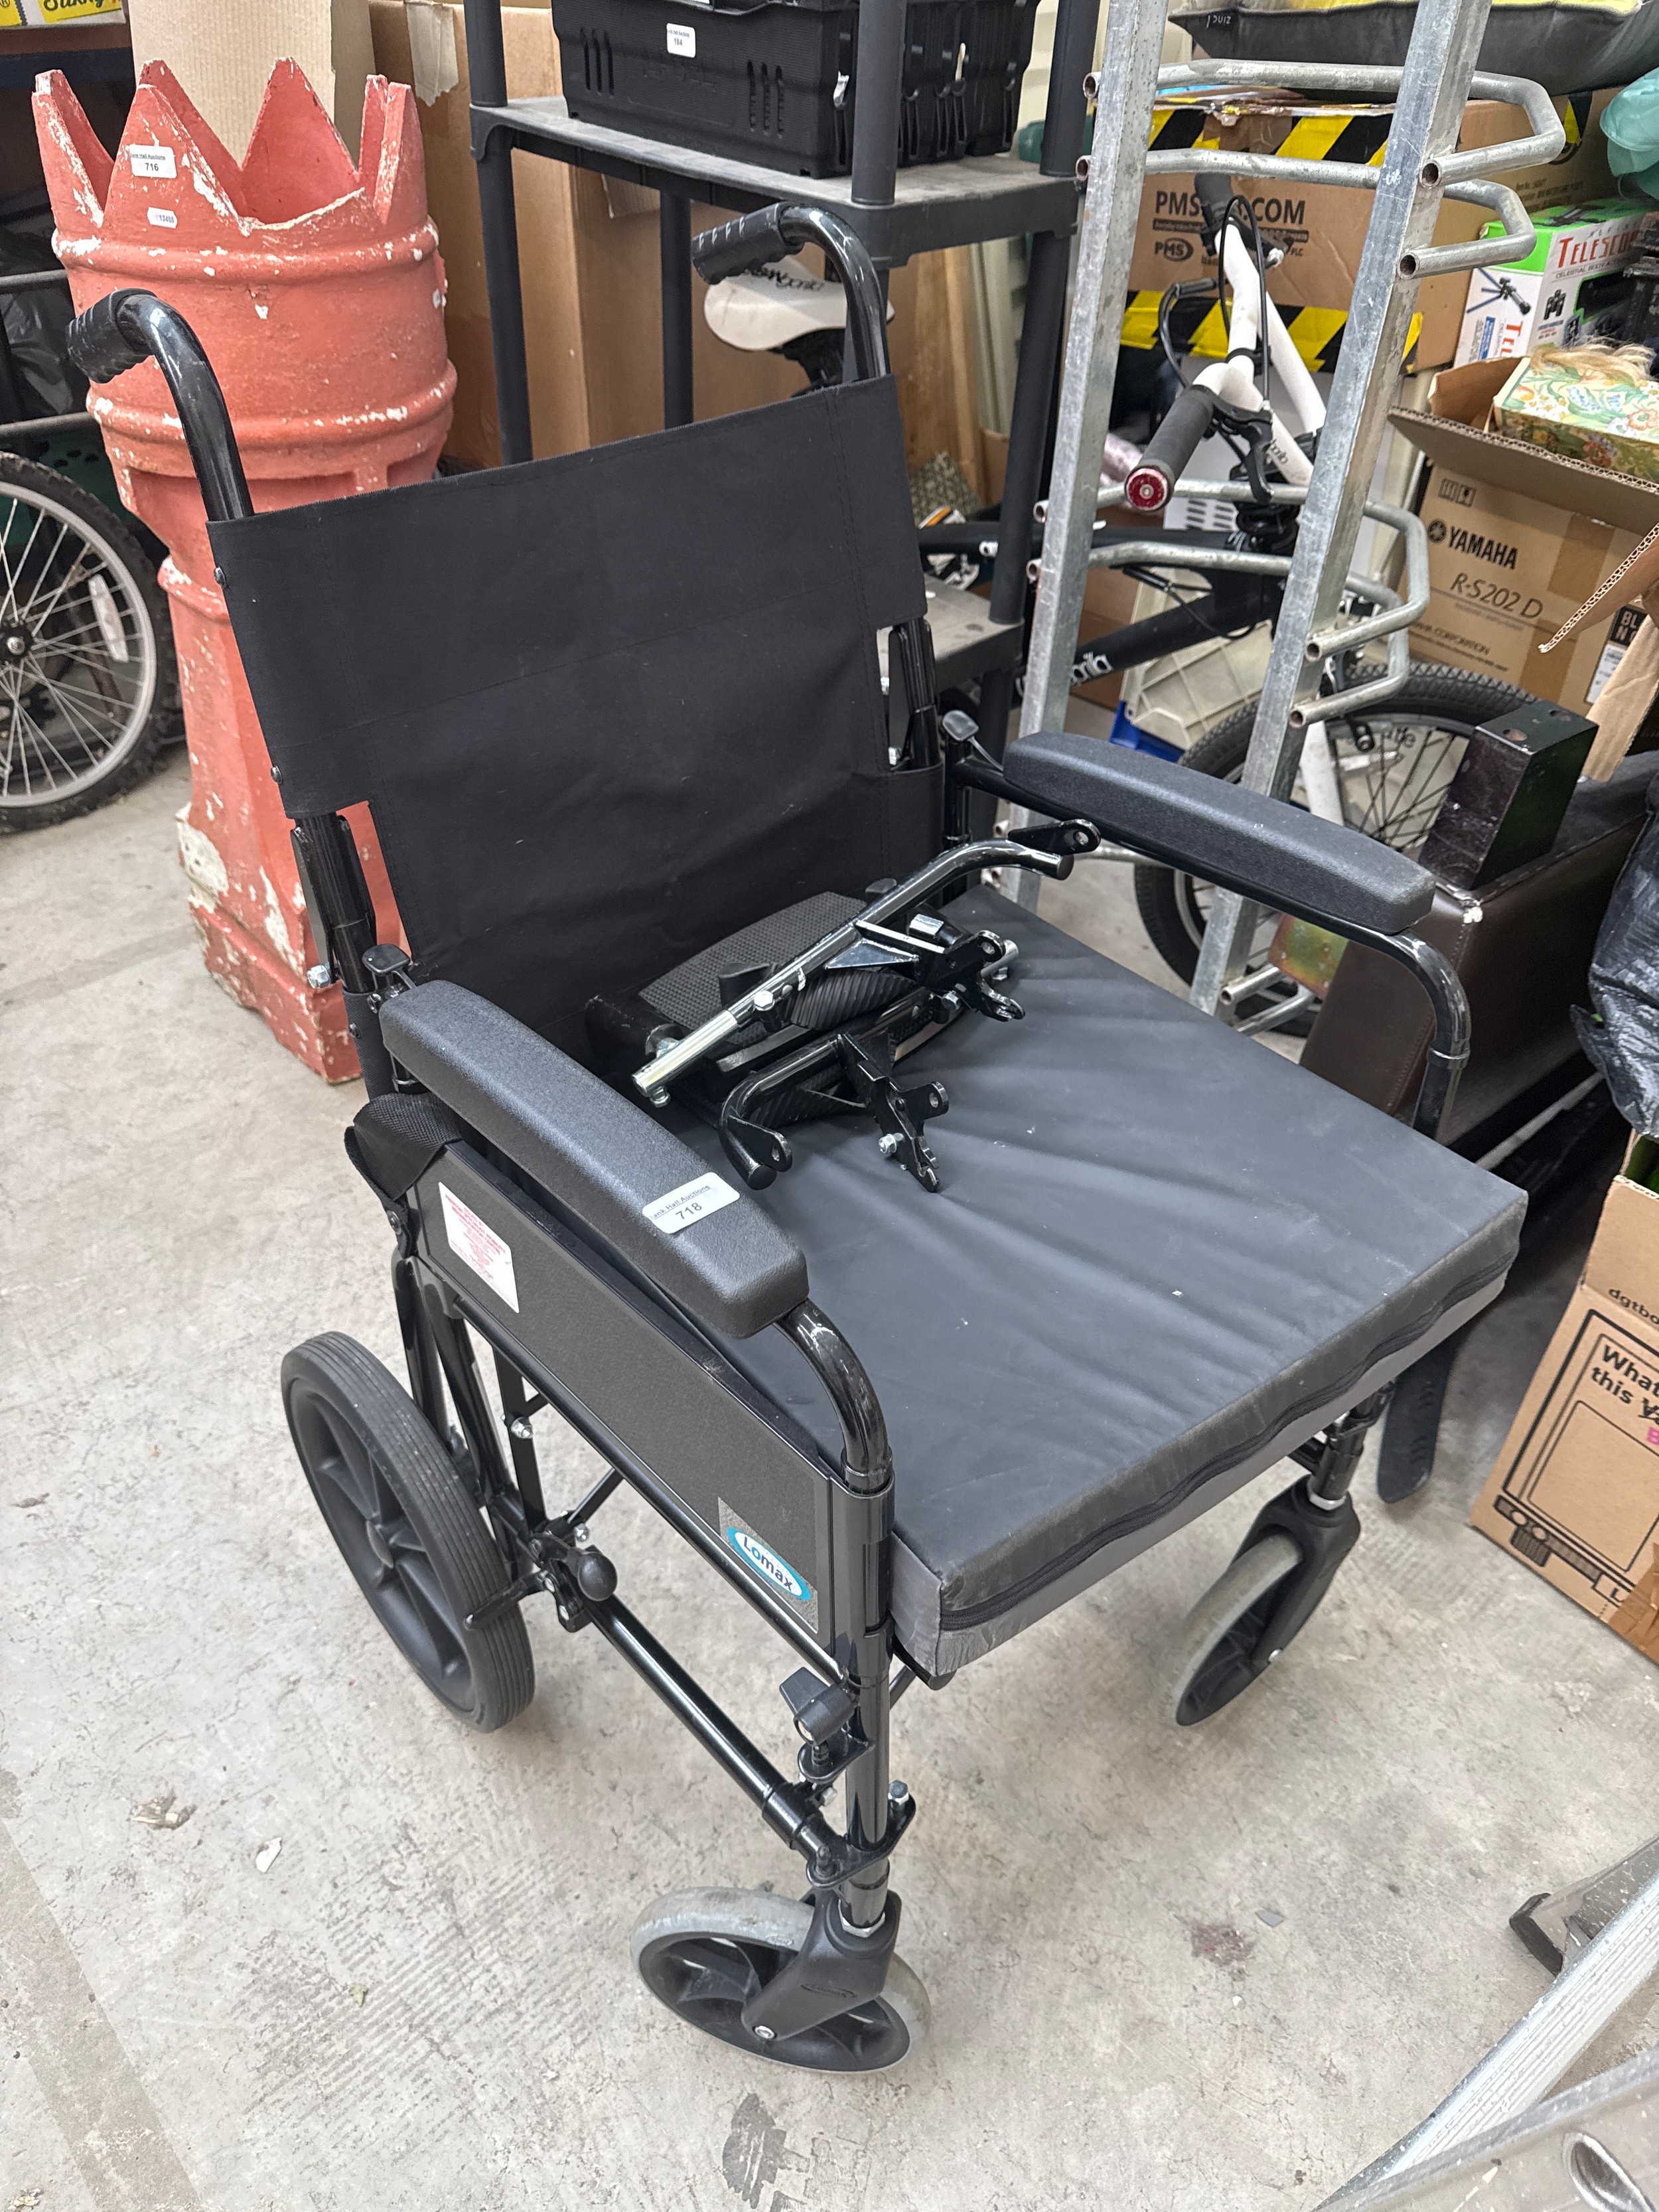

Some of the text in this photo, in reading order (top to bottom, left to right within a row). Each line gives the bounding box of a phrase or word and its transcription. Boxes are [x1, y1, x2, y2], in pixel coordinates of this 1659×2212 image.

[145, 162, 159, 171] 716
[1448, 526, 1518, 570] YAMAHA
[1450, 573, 1522, 613] R-S202
[1520, 598, 1544, 619] D
[666, 1200, 680, 1210] Hall
[680, 1185, 711, 1202] Auctions
[675, 1203, 703, 1220] 718
[1591, 1366, 1634, 1404] this
[743, 1536, 793, 1592] Lomax
